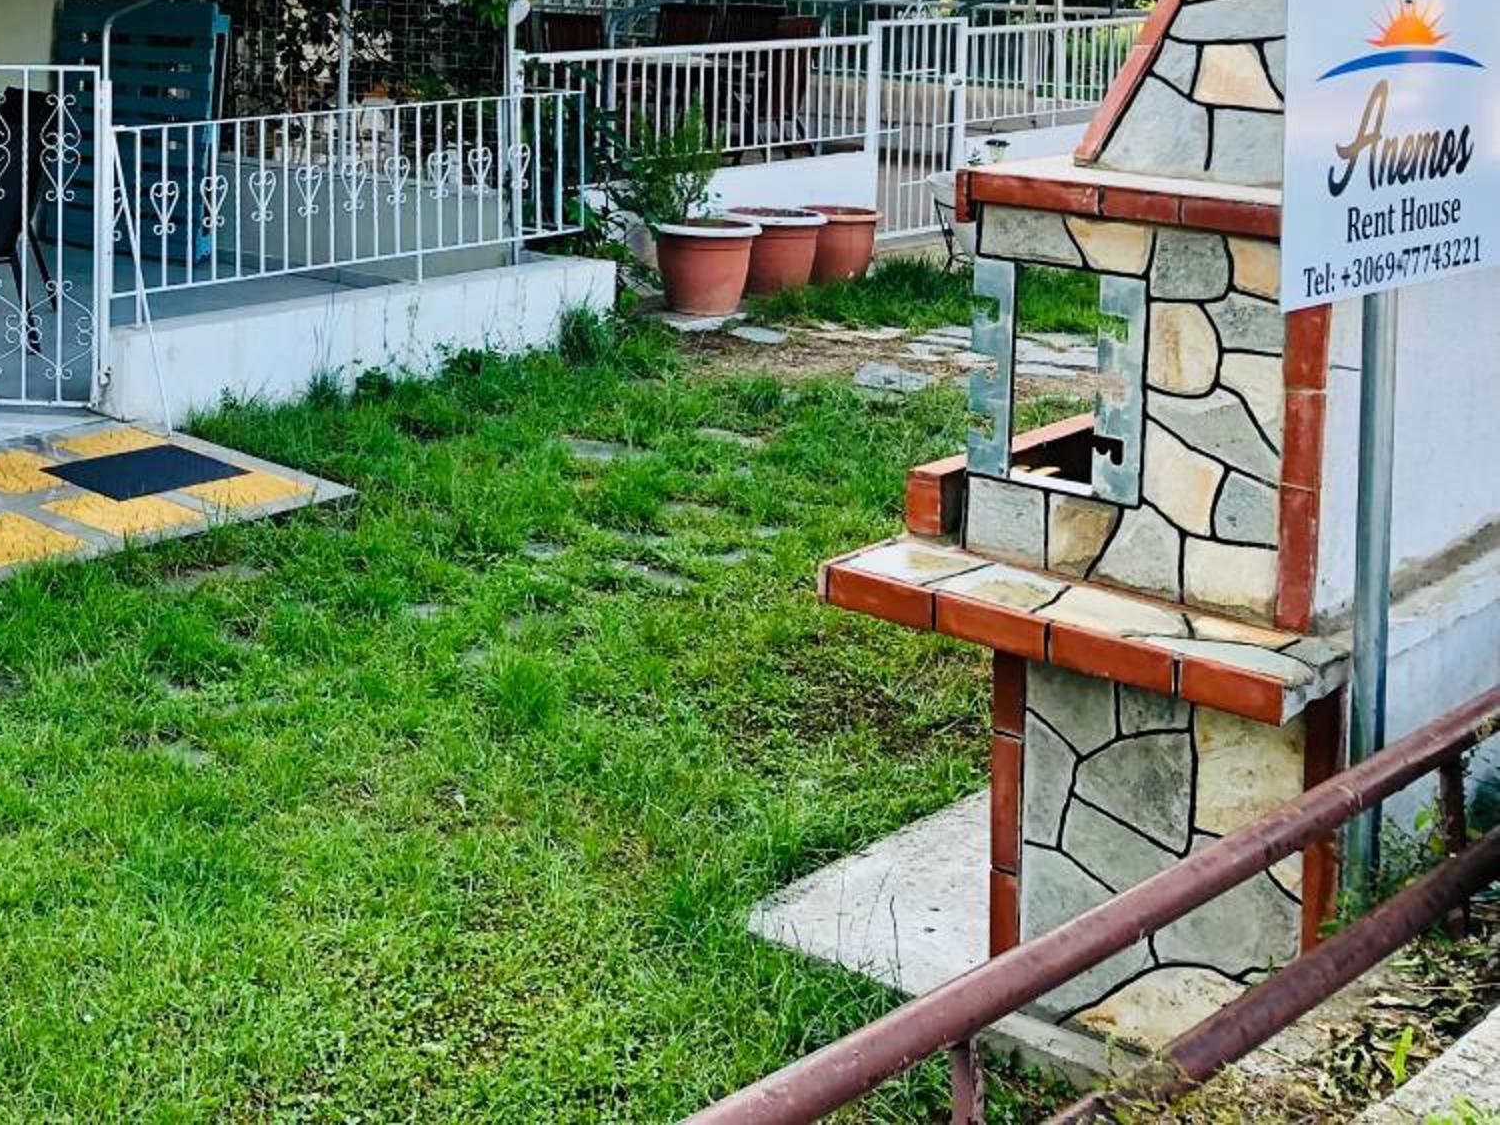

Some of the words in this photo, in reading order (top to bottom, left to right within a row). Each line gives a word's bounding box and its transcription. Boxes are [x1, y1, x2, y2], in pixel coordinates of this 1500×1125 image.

[1328, 79, 1474, 197] Anemos
[1347, 204, 1396, 243] Rent
[1401, 197, 1461, 233] House
[1303, 262, 1335, 297] Tel:
